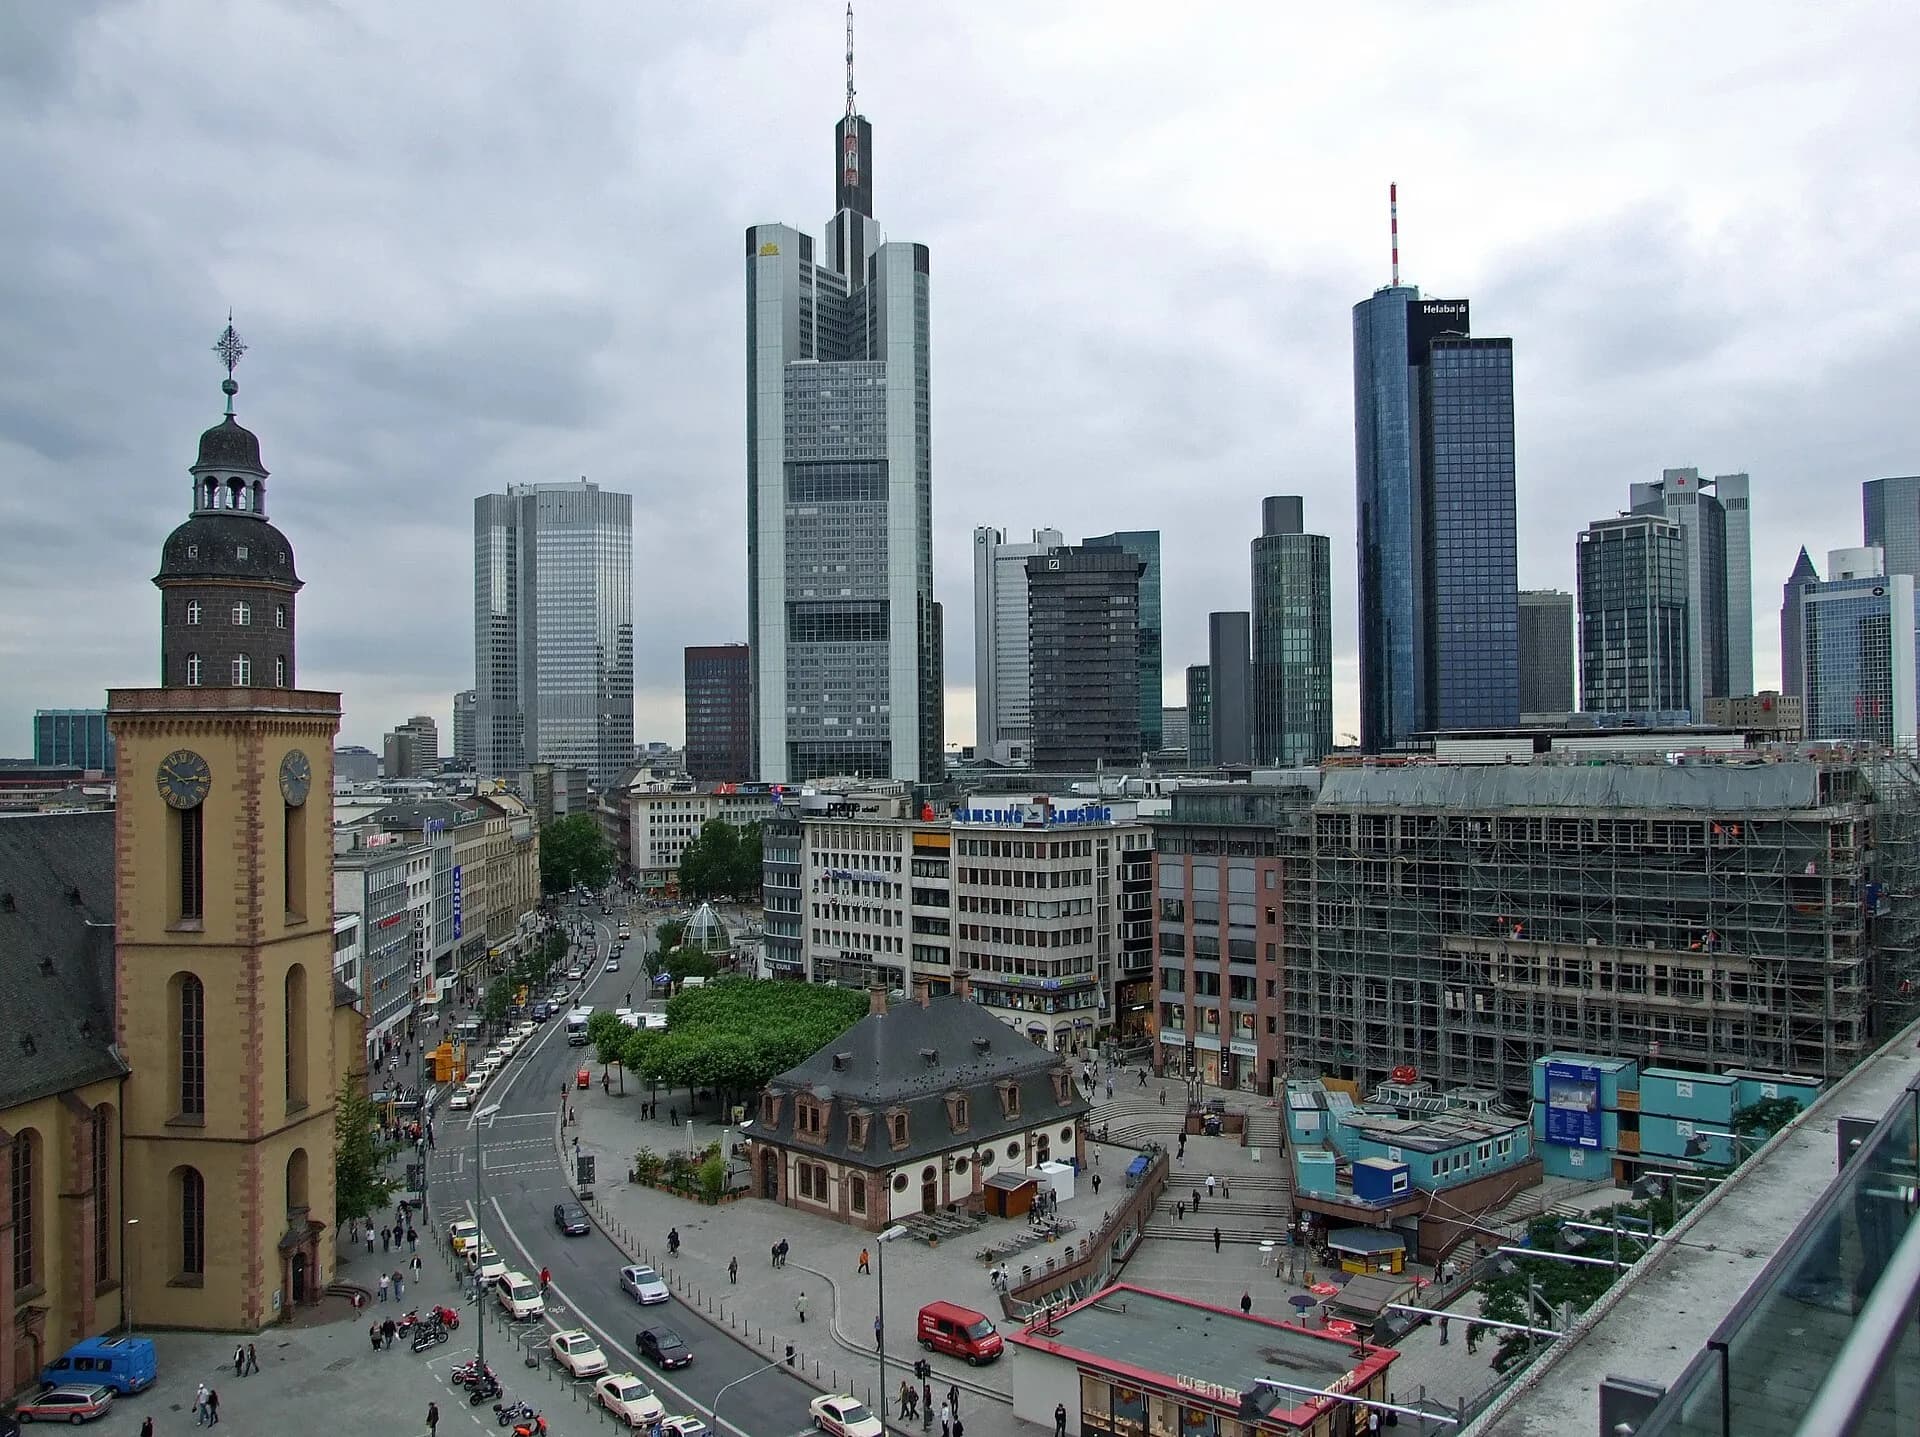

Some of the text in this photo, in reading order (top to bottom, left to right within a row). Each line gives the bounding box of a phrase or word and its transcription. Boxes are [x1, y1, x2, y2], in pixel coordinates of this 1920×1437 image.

[1423, 304, 1456, 314] Helaba
[954, 806, 1111, 824] SAMSUNG SAMSUNG
[414, 909, 423, 960] HOTEL
[840, 950, 873, 962] PRANGE
